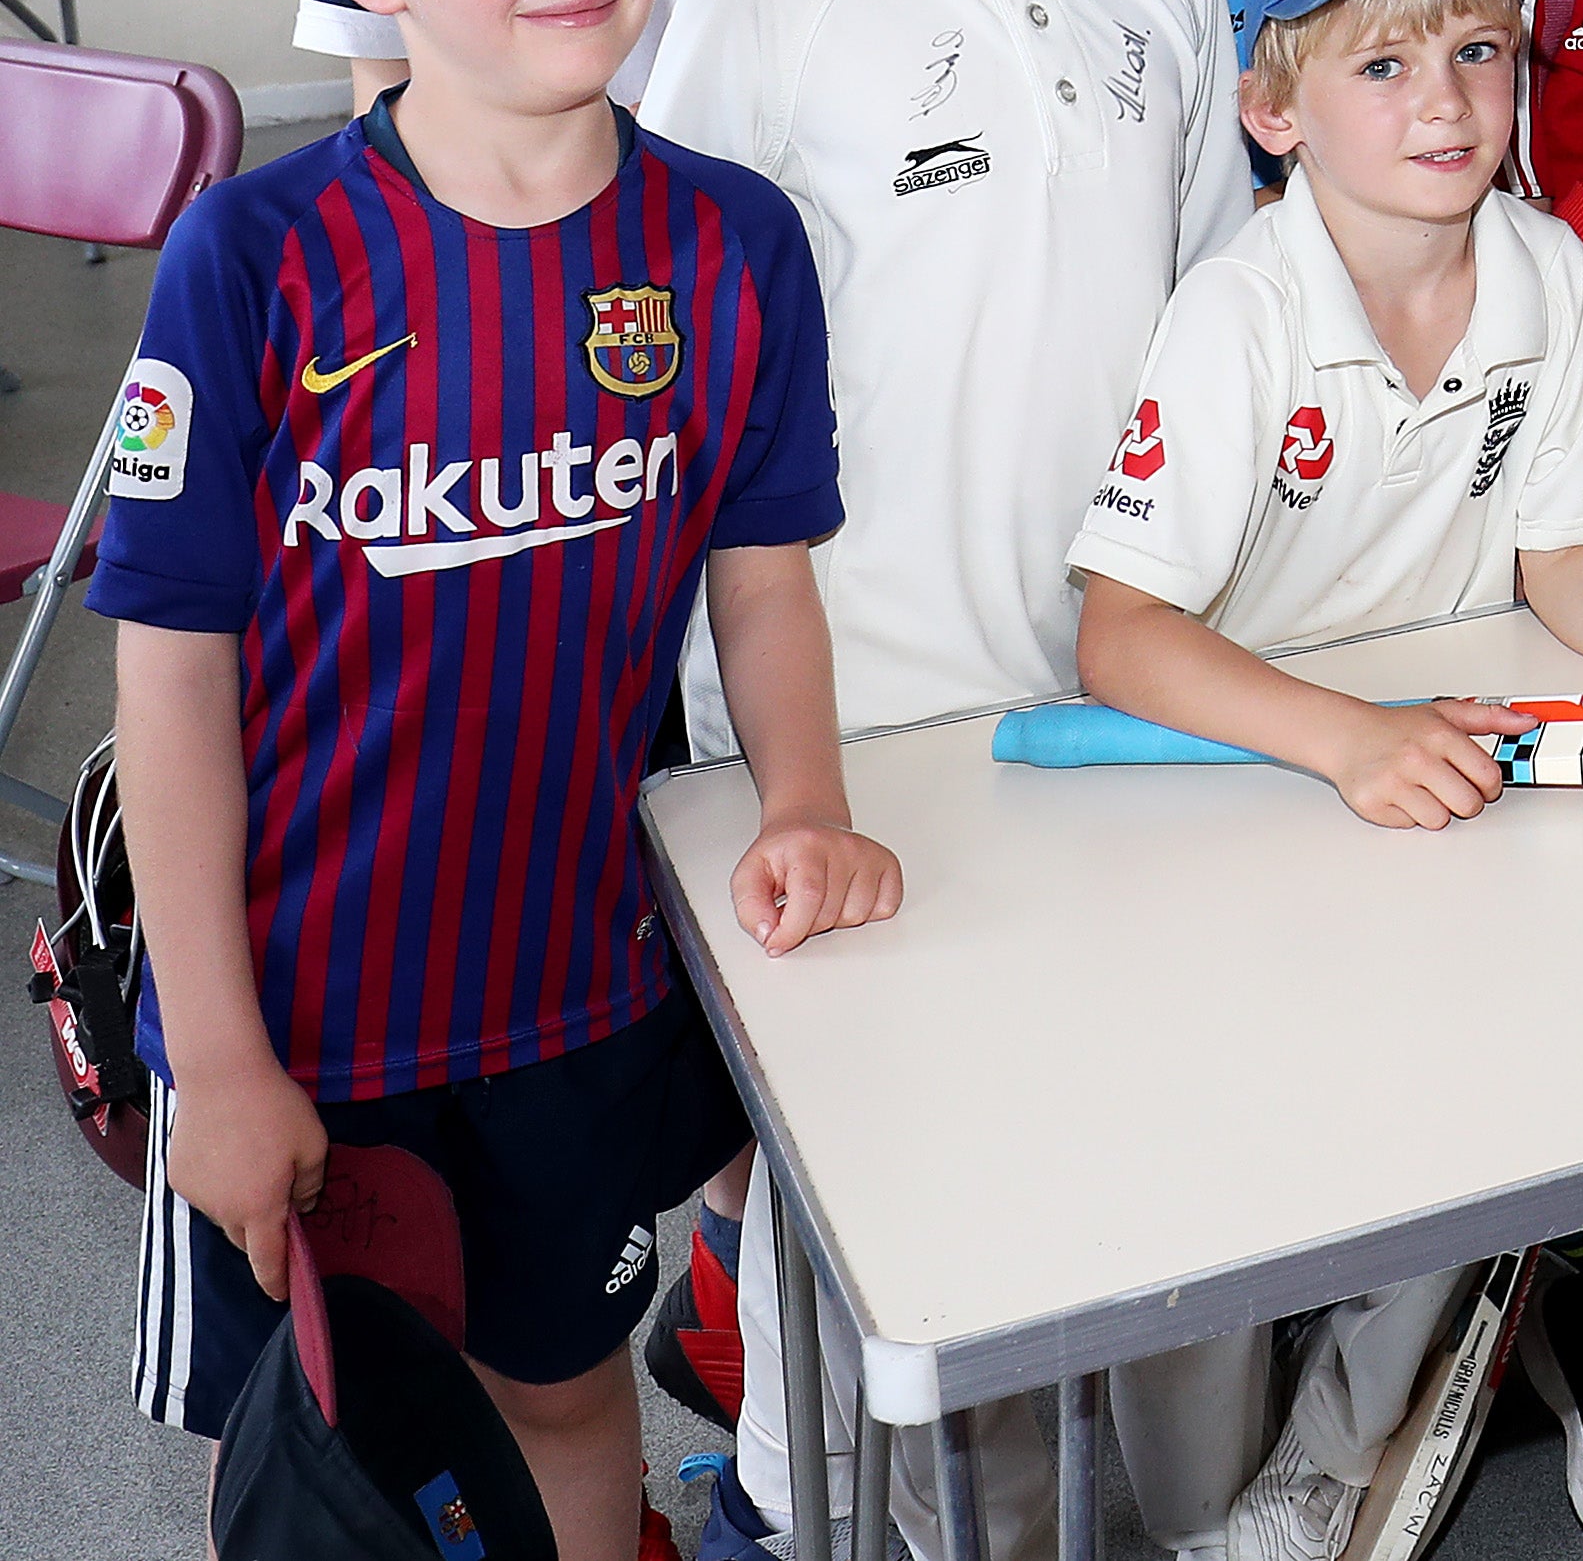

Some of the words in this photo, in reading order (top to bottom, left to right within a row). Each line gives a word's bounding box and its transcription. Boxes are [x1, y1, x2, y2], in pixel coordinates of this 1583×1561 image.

[892, 155, 991, 195] Slazenger
[618, 332, 655, 346] FCB
[112, 457, 170, 483] aLiga
[283, 431, 682, 548] Rakuten
[1432, 1358, 1478, 1440] GRAY-NICOLLS
